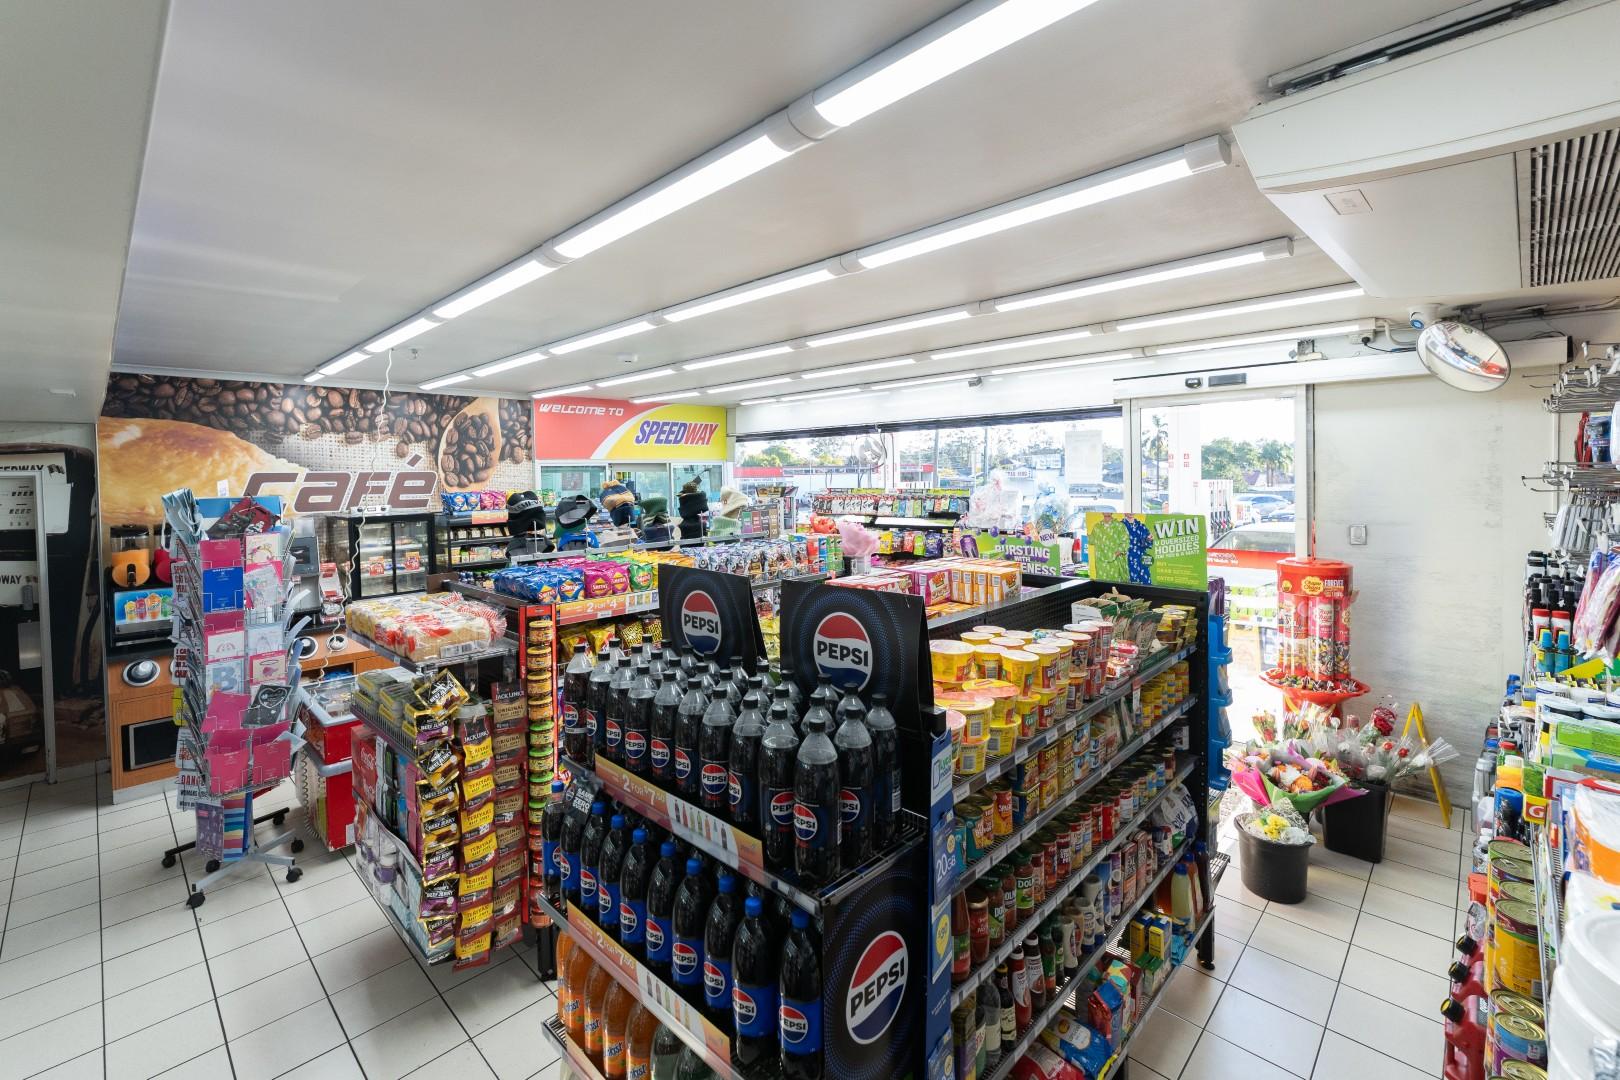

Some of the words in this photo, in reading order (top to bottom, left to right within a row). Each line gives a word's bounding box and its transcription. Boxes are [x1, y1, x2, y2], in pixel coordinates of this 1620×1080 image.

[635, 420, 719, 446] SPEEDWAY
[1154, 517, 1199, 540] WIN
[1040, 534, 1054, 542] NEW
[994, 544, 1050, 558] BURSTING
[1155, 542, 1200, 554] HOODIES
[1022, 563, 1056, 576] ENESS
[586, 602, 594, 612] 2
[684, 613, 719, 634] PEPSI
[817, 640, 868, 667] PEPSI
[622, 774, 630, 792] 2
[702, 774, 726, 782] PEPSI
[842, 802, 858, 812] PSI
[796, 818, 816, 829] EPSI
[674, 953, 696, 964] PEPSI
[850, 956, 904, 1018] PEPSI
[784, 1020, 806, 1030] EPSI
